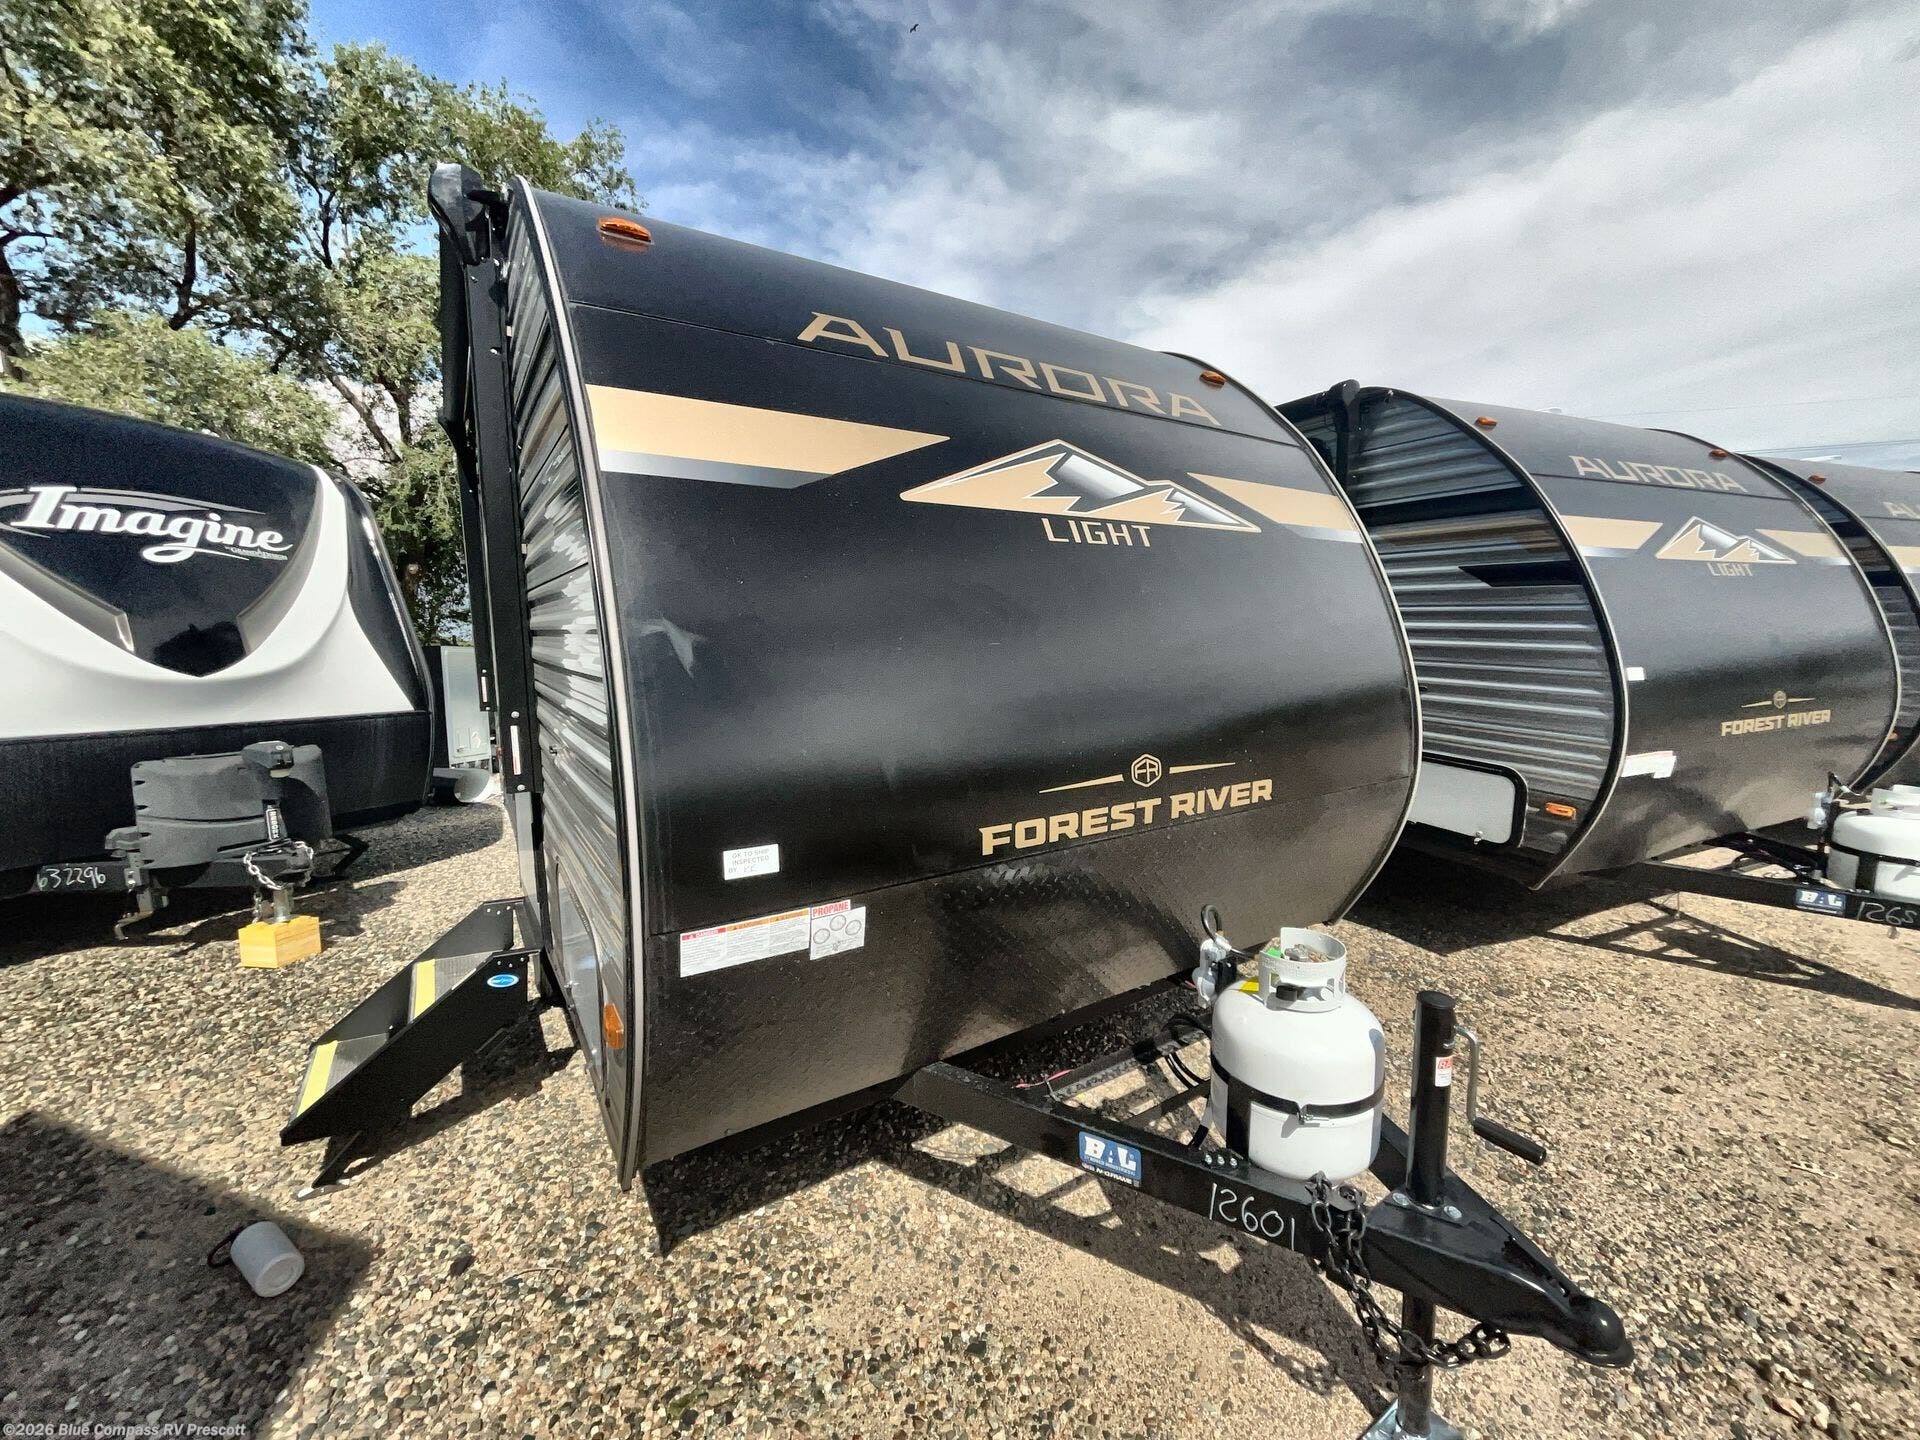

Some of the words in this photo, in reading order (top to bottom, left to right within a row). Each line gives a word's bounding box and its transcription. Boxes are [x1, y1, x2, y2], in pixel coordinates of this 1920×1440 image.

[797, 311, 1222, 426] AURORA
[1569, 455, 1748, 493] AURORA
[10, 485, 294, 563] Imagine
[1041, 517, 1151, 547] LIGHT
[1707, 562, 1753, 577] LIGHT
[1721, 714, 1785, 737] FOREST
[1786, 709, 1831, 728] RIVER
[978, 797, 1162, 856] FOREST
[1169, 778, 1273, 819] RIVER
[37, 866, 106, 891] 632296
[812, 902, 850, 919] PROPANE
[1209, 1182, 1296, 1252] 12601
